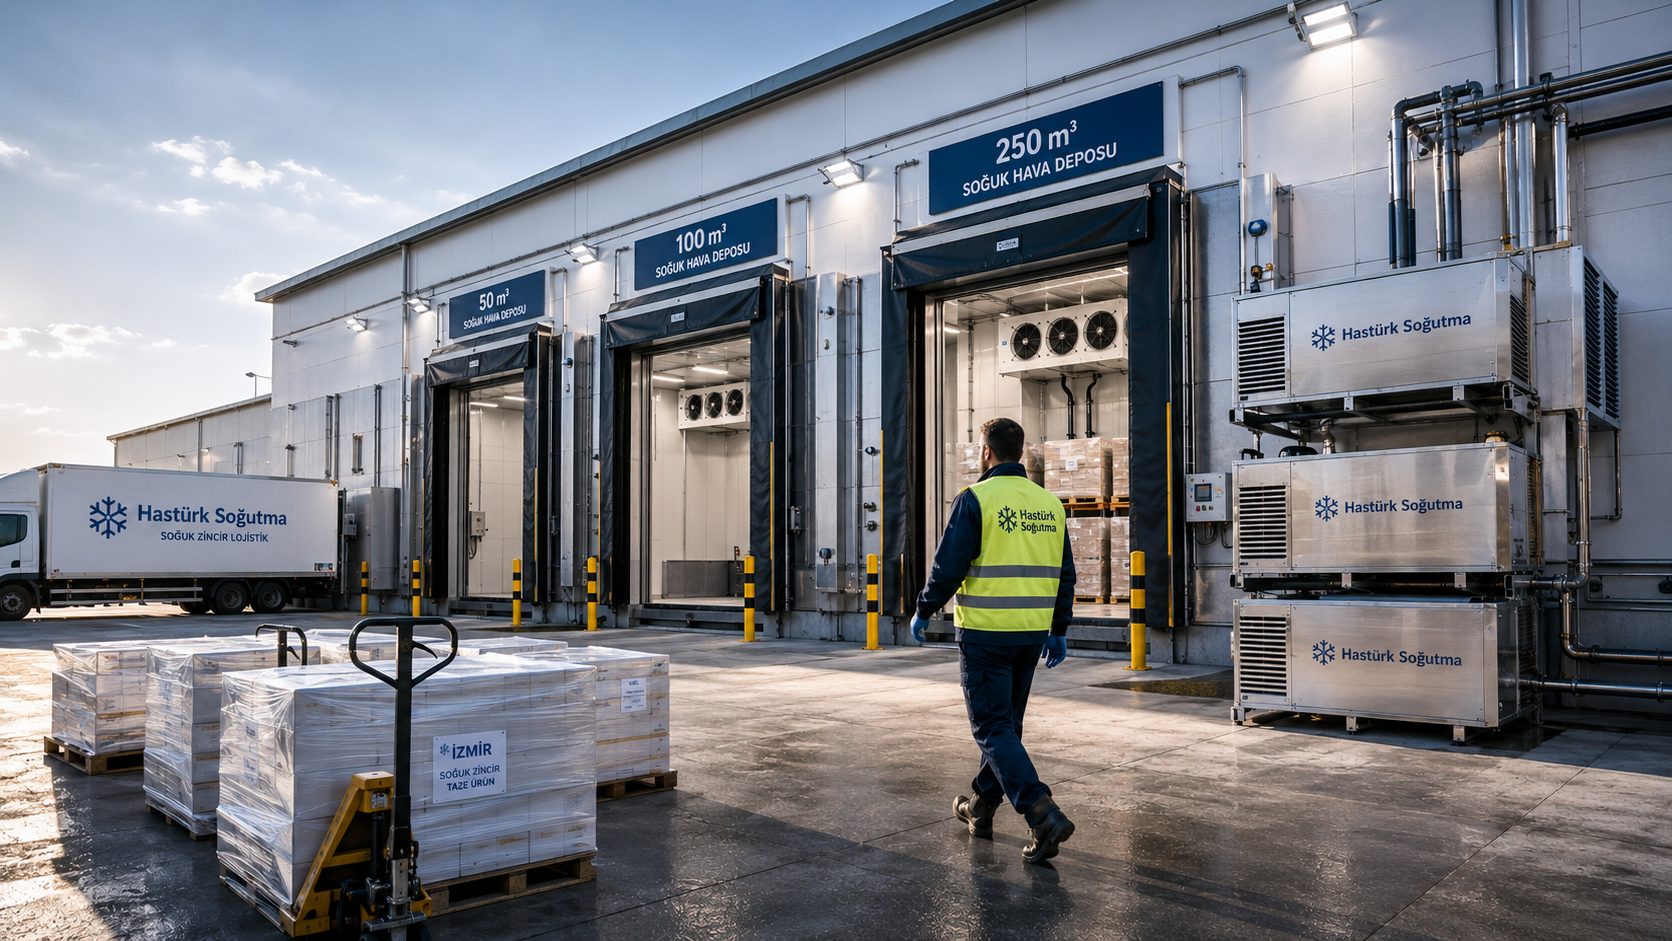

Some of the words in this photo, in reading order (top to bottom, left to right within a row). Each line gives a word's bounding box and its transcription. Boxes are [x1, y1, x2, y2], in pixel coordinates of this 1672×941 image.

[996, 128, 1042, 165] 250
[962, 171, 1010, 197] SOĞUK
[1013, 161, 1051, 183] HAVA
[1055, 142, 1118, 173] DEPOSU
[676, 228, 705, 254] 100
[655, 260, 685, 278] SOĞUK
[687, 253, 711, 270] HAVA
[712, 241, 751, 262] DEPOSU
[479, 292, 494, 311] 50
[501, 304, 527, 320] DEPOSU
[1342, 321, 1399, 341] Hastürk
[1403, 314, 1471, 333] Soğutma
[1019, 509, 1056, 521] Hastürk
[1344, 499, 1398, 514] Hastürk
[1401, 498, 1463, 514] Soğutma
[137, 504, 210, 523] Hastürk
[214, 507, 287, 528] Soğutma
[160, 530, 195, 542] SOĞUK
[197, 531, 228, 542] ZİNCİR
[230, 532, 269, 543] LOJİSTİK
[1021, 521, 1057, 534] Soğutma
[1341, 647, 1395, 663] Hastürk
[1399, 650, 1462, 668] Soğutma
[452, 740, 492, 760] İZMİR
[440, 767, 471, 780] SOĞUK
[472, 764, 501, 776] ZİNCİR
[470, 777, 495, 789] ÜRÜN
